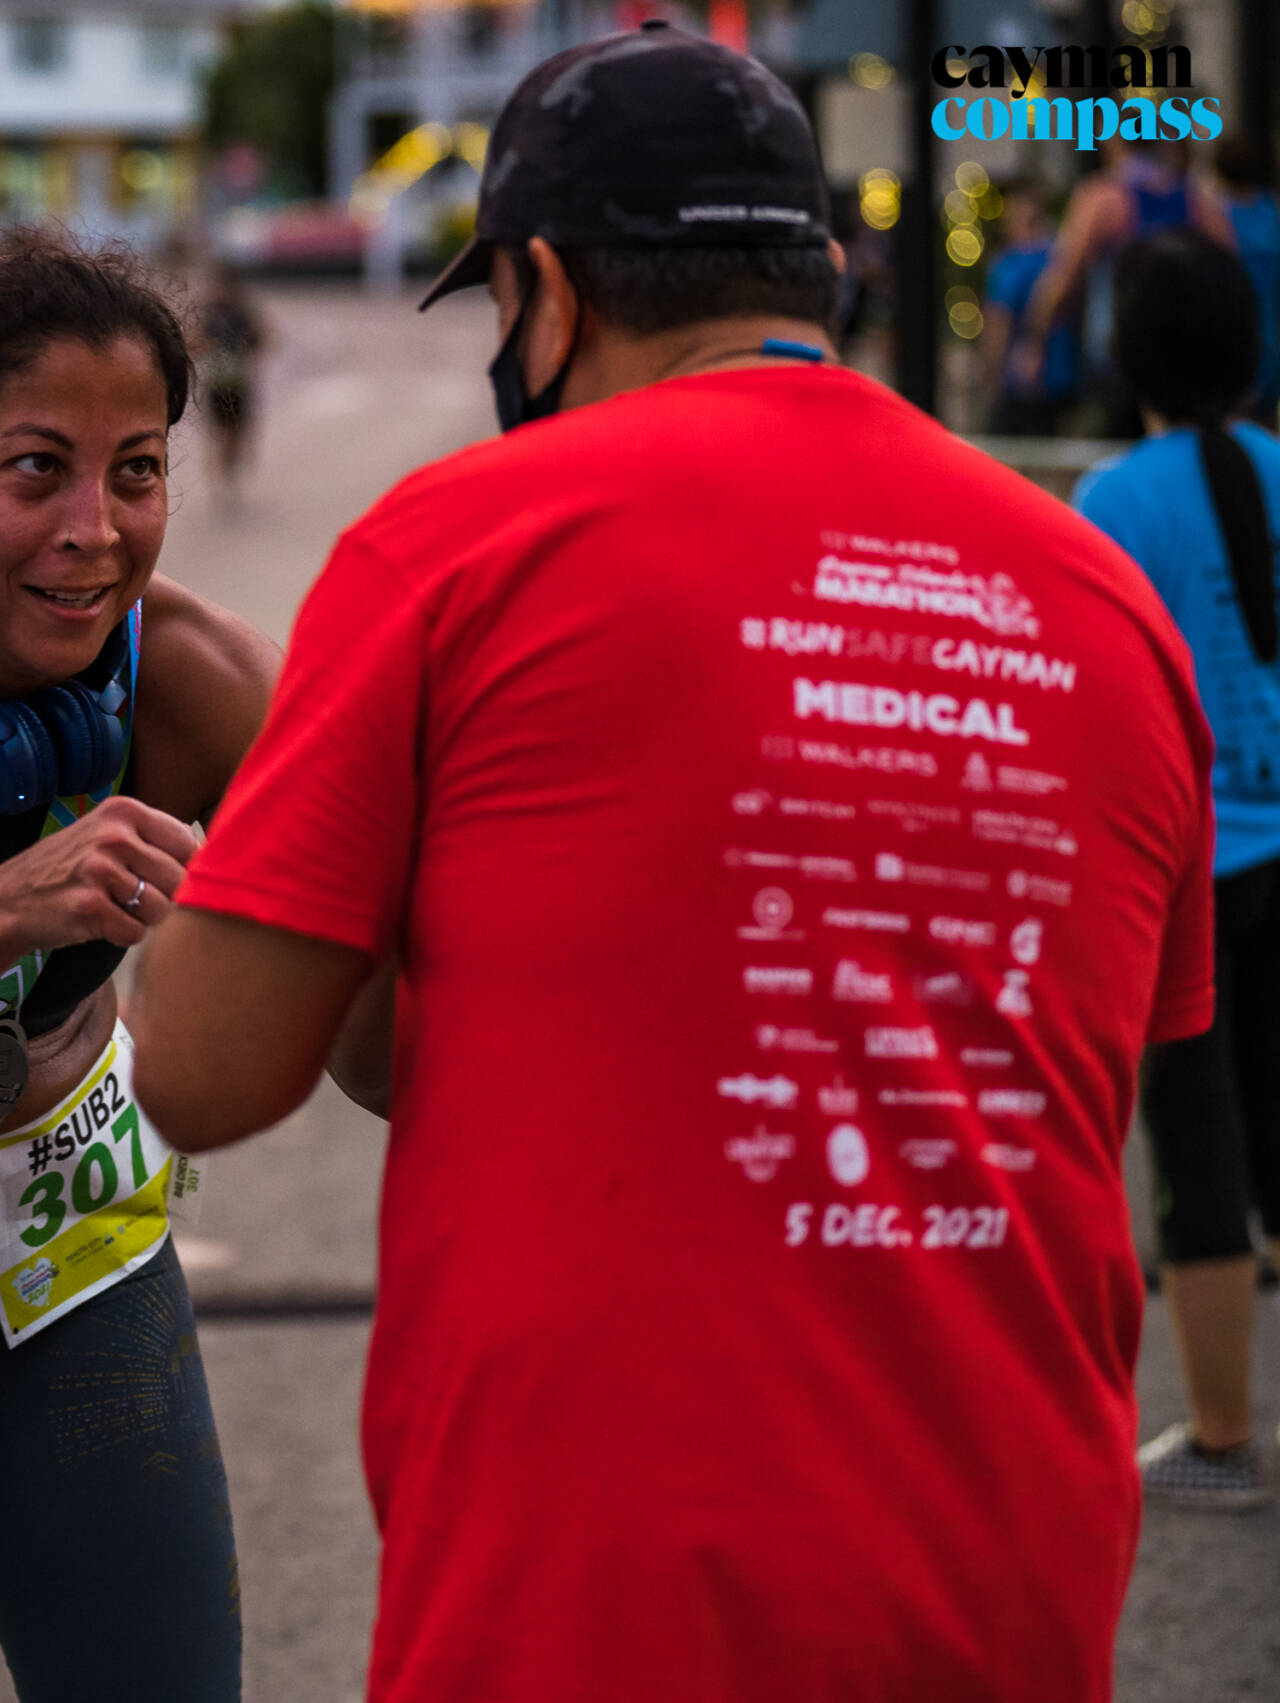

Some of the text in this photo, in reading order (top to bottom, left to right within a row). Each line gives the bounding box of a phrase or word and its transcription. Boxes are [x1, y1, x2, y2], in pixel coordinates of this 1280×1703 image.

[792, 677, 1029, 746] MEDICAL
[27, 1071, 126, 1177] #SUB2
[17, 1101, 150, 1248] 307
[785, 1202, 1010, 1250] 5 DEC. 2021
